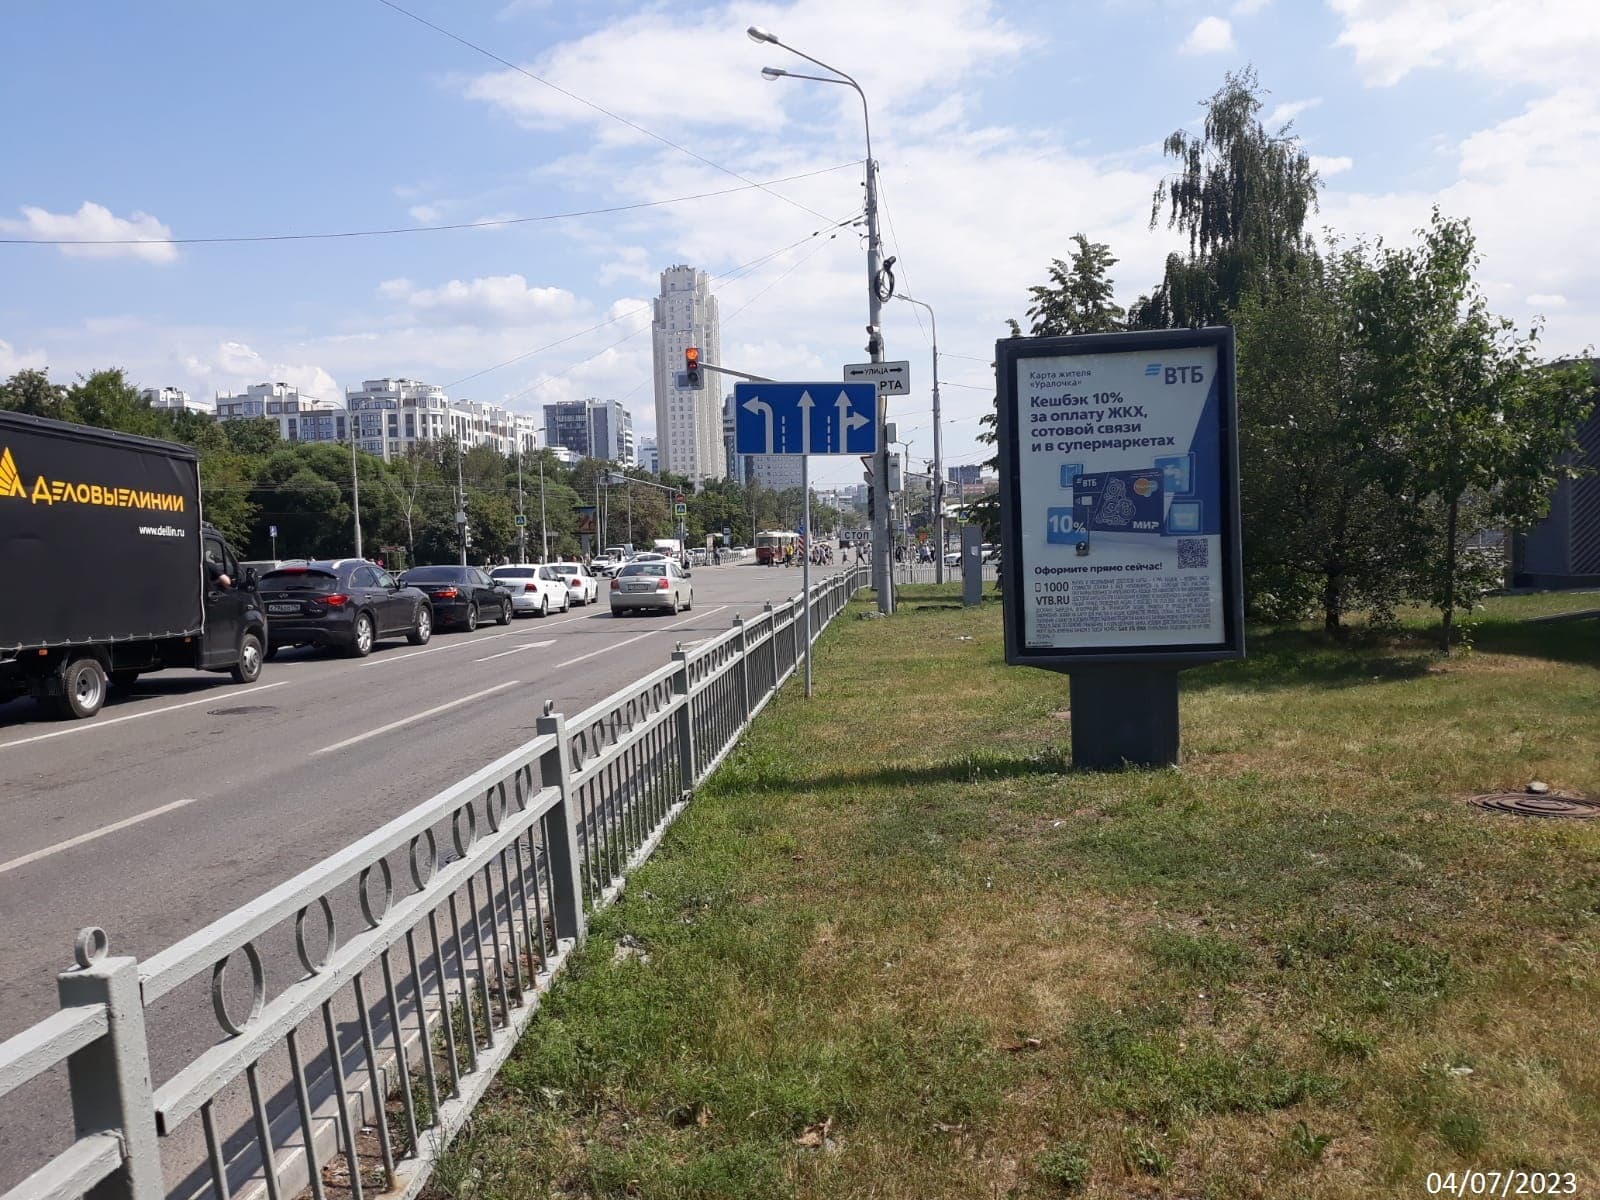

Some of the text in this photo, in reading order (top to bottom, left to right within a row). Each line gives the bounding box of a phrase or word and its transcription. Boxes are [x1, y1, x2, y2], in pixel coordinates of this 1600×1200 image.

[864, 367, 889, 375] УЛИЦА
[1030, 369, 1091, 380] Карта жителя
[1165, 366, 1204, 385] ВТБ
[877, 380, 903, 391] РТА
[1030, 379, 1082, 389] «Уралочка»
[1030, 392, 1124, 408] Кешбэк 10%
[1030, 405, 1148, 423] за оплату ЖКХ,
[1031, 423, 1142, 437] сотовой связи
[1031, 436, 1176, 453] и в супермаркетах
[1082, 479, 1097, 487] ВТБ
[1133, 520, 1160, 530] МИР
[138, 525, 185, 538] www.dellin.ru
[844, 532, 869, 540] СТОП
[1034, 562, 1163, 576] Оформите прямо сейчас!
[1043, 581, 1069, 592] 1000
[1035, 595, 1070, 605] VTB.RU
